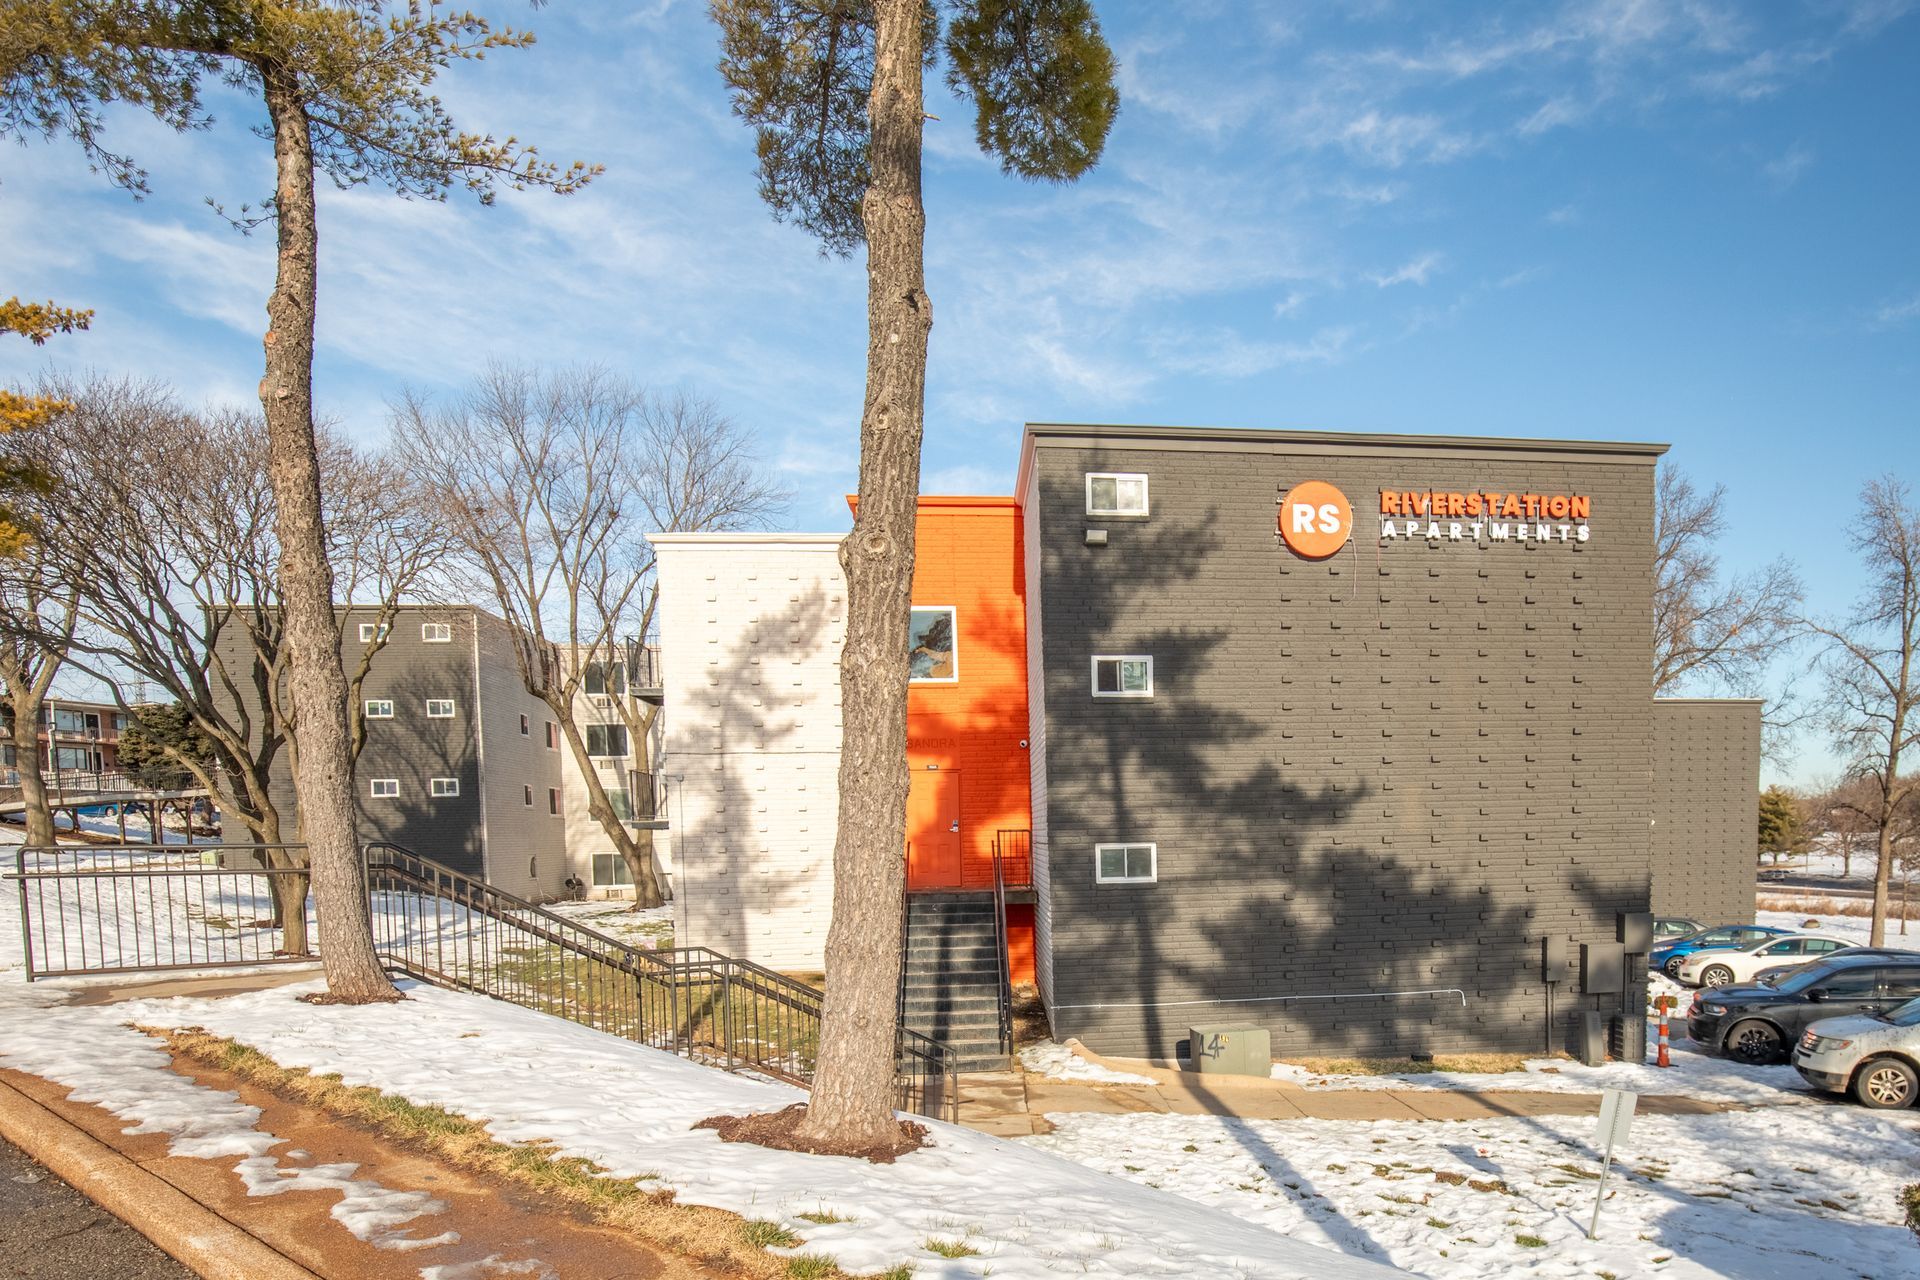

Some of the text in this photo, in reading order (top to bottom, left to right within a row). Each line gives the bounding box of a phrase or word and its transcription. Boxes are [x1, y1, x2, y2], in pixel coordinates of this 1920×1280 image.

[1381, 491, 1590, 518] RIVERSTATION
[1292, 503, 1341, 534] RS
[1382, 520, 1590, 542] APARTMENTS
